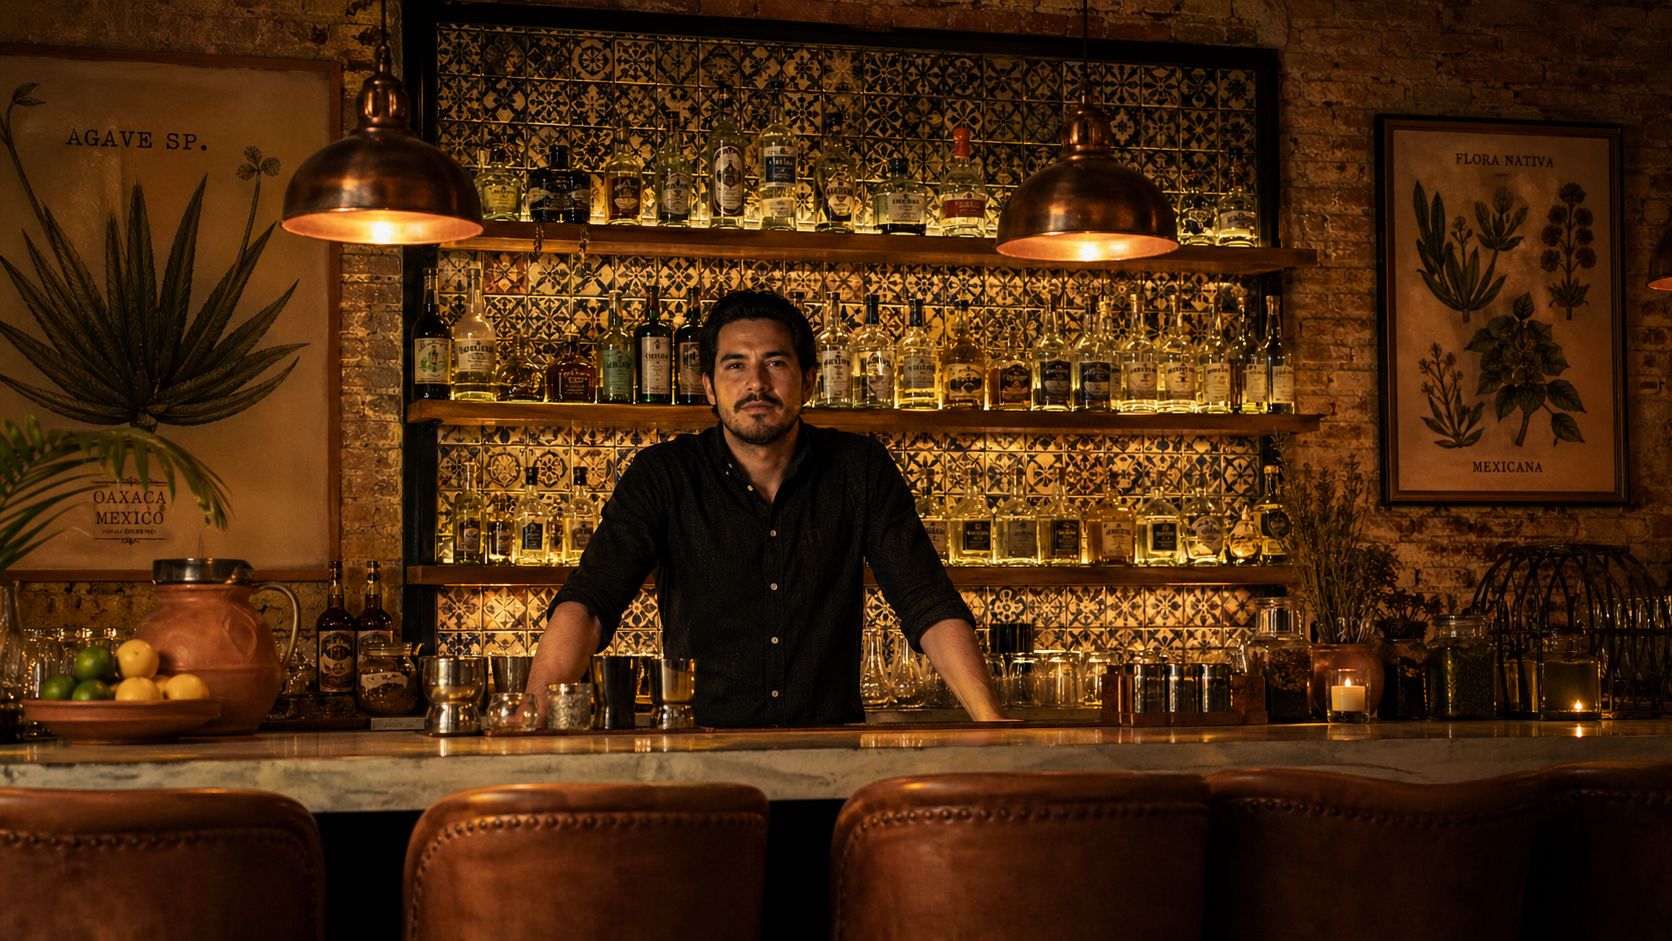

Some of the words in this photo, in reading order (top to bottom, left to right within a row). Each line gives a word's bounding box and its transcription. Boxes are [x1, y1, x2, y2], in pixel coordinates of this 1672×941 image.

[66, 129, 152, 149] AGAVE
[166, 133, 207, 151] SP.
[1456, 153, 1500, 165] FLORA
[1505, 155, 1554, 168] NATIVA
[1472, 461, 1543, 473] MEXICANA
[93, 490, 166, 504] OAXACA
[96, 511, 164, 525] MEXICO
